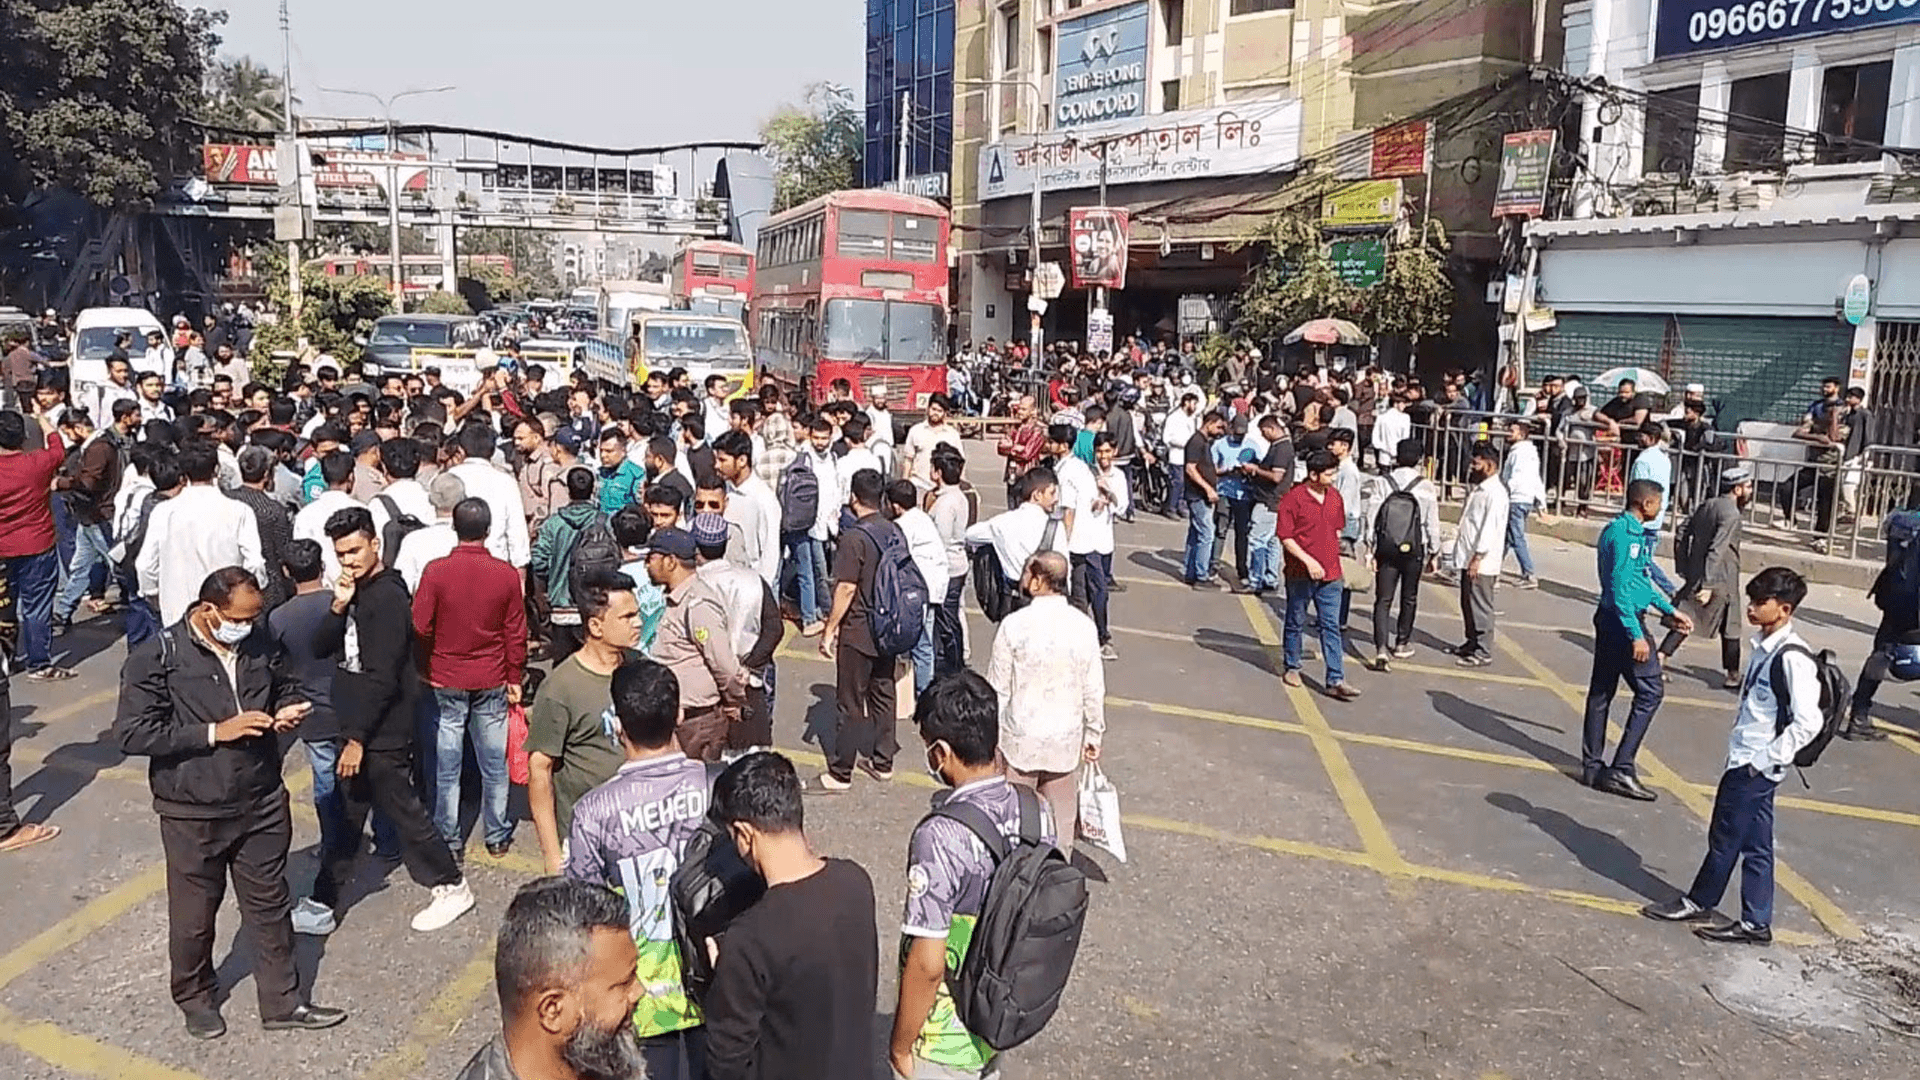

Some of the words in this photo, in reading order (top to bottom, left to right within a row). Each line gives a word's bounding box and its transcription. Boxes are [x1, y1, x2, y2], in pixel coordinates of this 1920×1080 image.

[1689, 0, 1917, 43] 096667755
[1059, 92, 1139, 121] CONCORD
[905, 175, 942, 197] TOWER
[619, 788, 708, 837] MEHEDI
